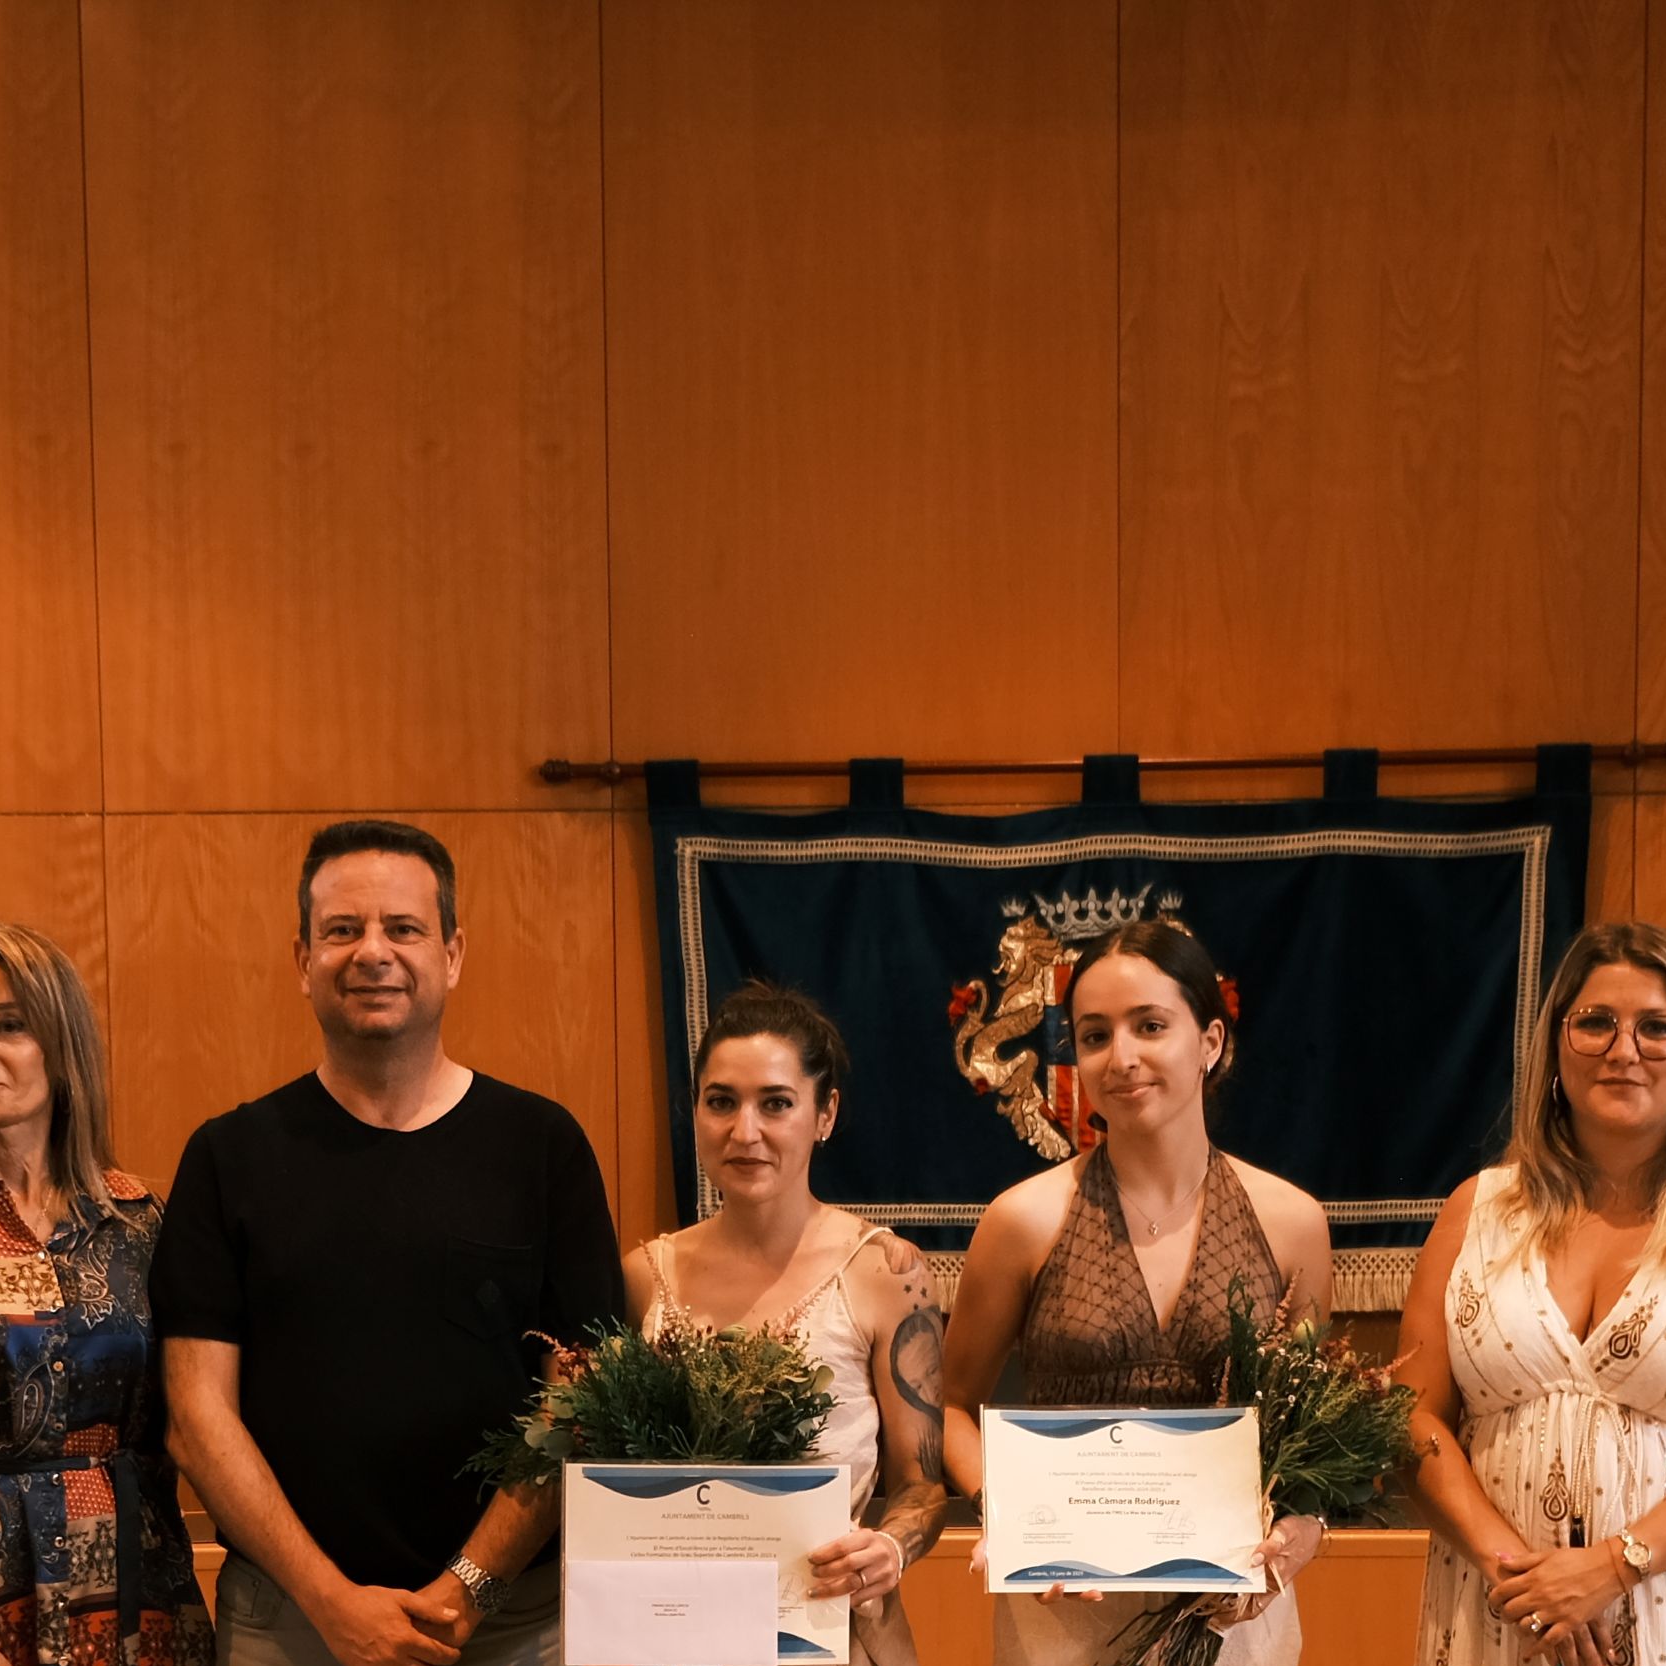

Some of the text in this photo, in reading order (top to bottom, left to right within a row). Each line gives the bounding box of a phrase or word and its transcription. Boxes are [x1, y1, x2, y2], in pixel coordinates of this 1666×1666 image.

[1110, 1425, 1123, 1444] C
[697, 1484, 711, 1505] C
[1068, 1497, 1097, 1505] Emma
